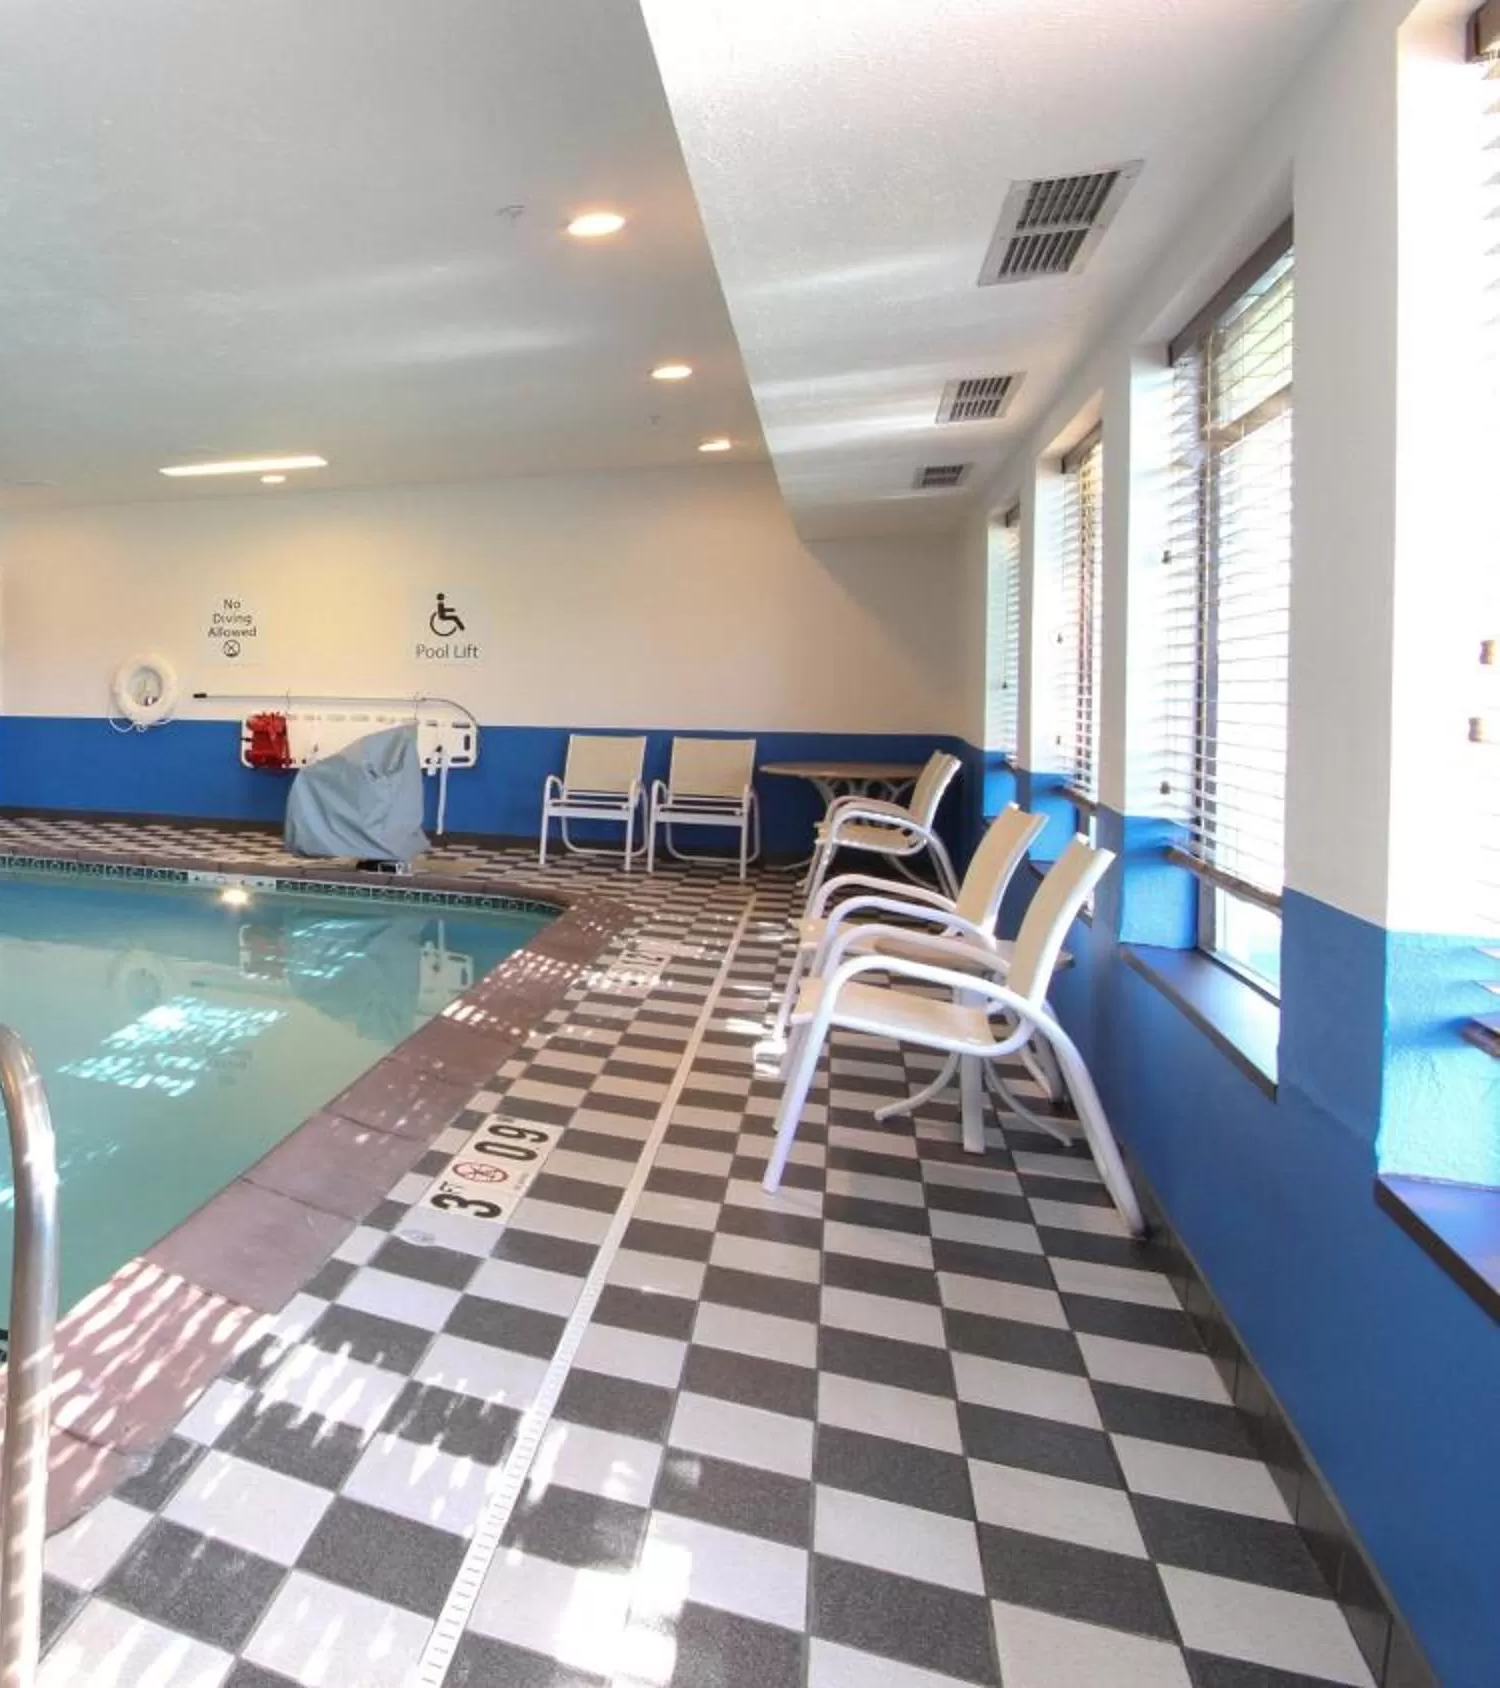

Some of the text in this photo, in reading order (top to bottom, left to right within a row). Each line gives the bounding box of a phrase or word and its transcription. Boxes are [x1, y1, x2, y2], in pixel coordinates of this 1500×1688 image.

[223, 599, 242, 609] No
[212, 612, 253, 627] Diving
[207, 626, 257, 637] Allowed
[416, 643, 480, 659] Pool Lift
